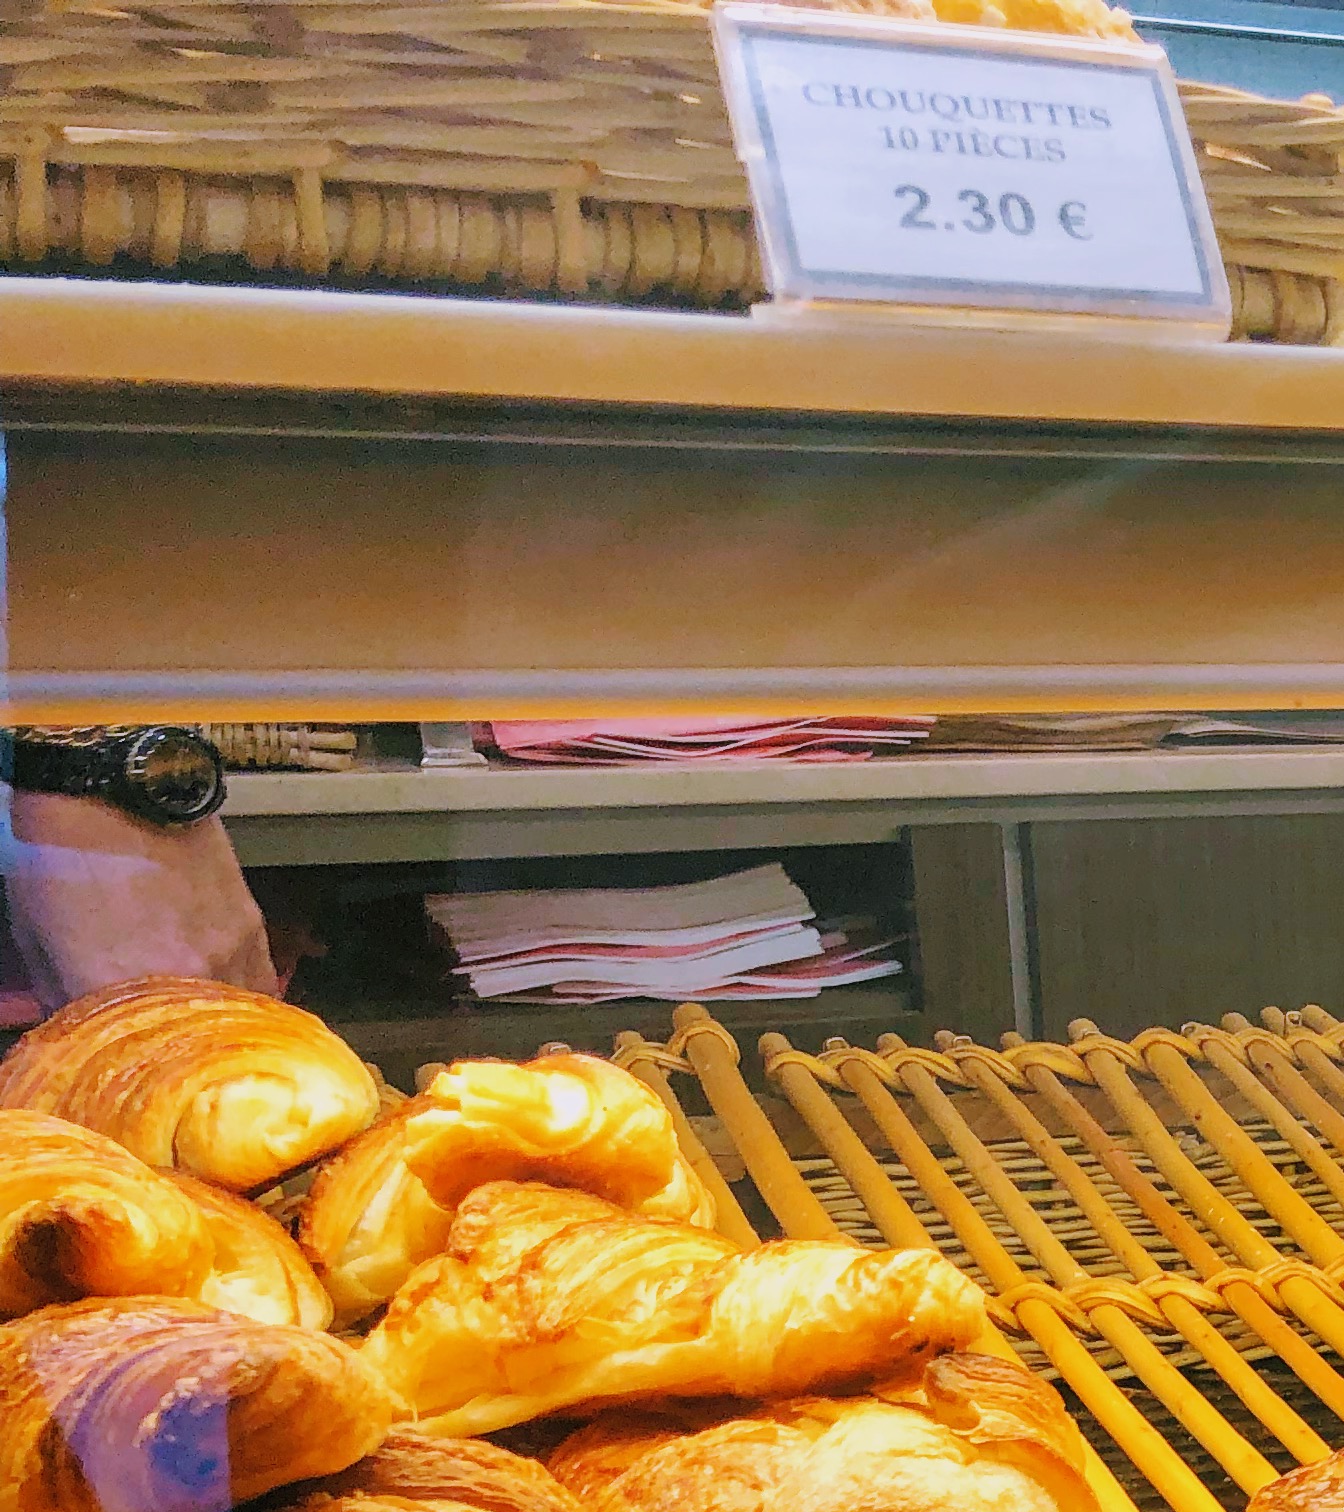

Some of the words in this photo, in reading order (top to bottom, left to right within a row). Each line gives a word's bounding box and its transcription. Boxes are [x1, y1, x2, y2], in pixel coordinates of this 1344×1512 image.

[803, 82, 1111, 128] CHOUQUETTES
[884, 126, 920, 150] 10
[932, 126, 1067, 163] PIÈCES
[894, 184, 1036, 236] 2.30
[1058, 201, 1094, 242] €
